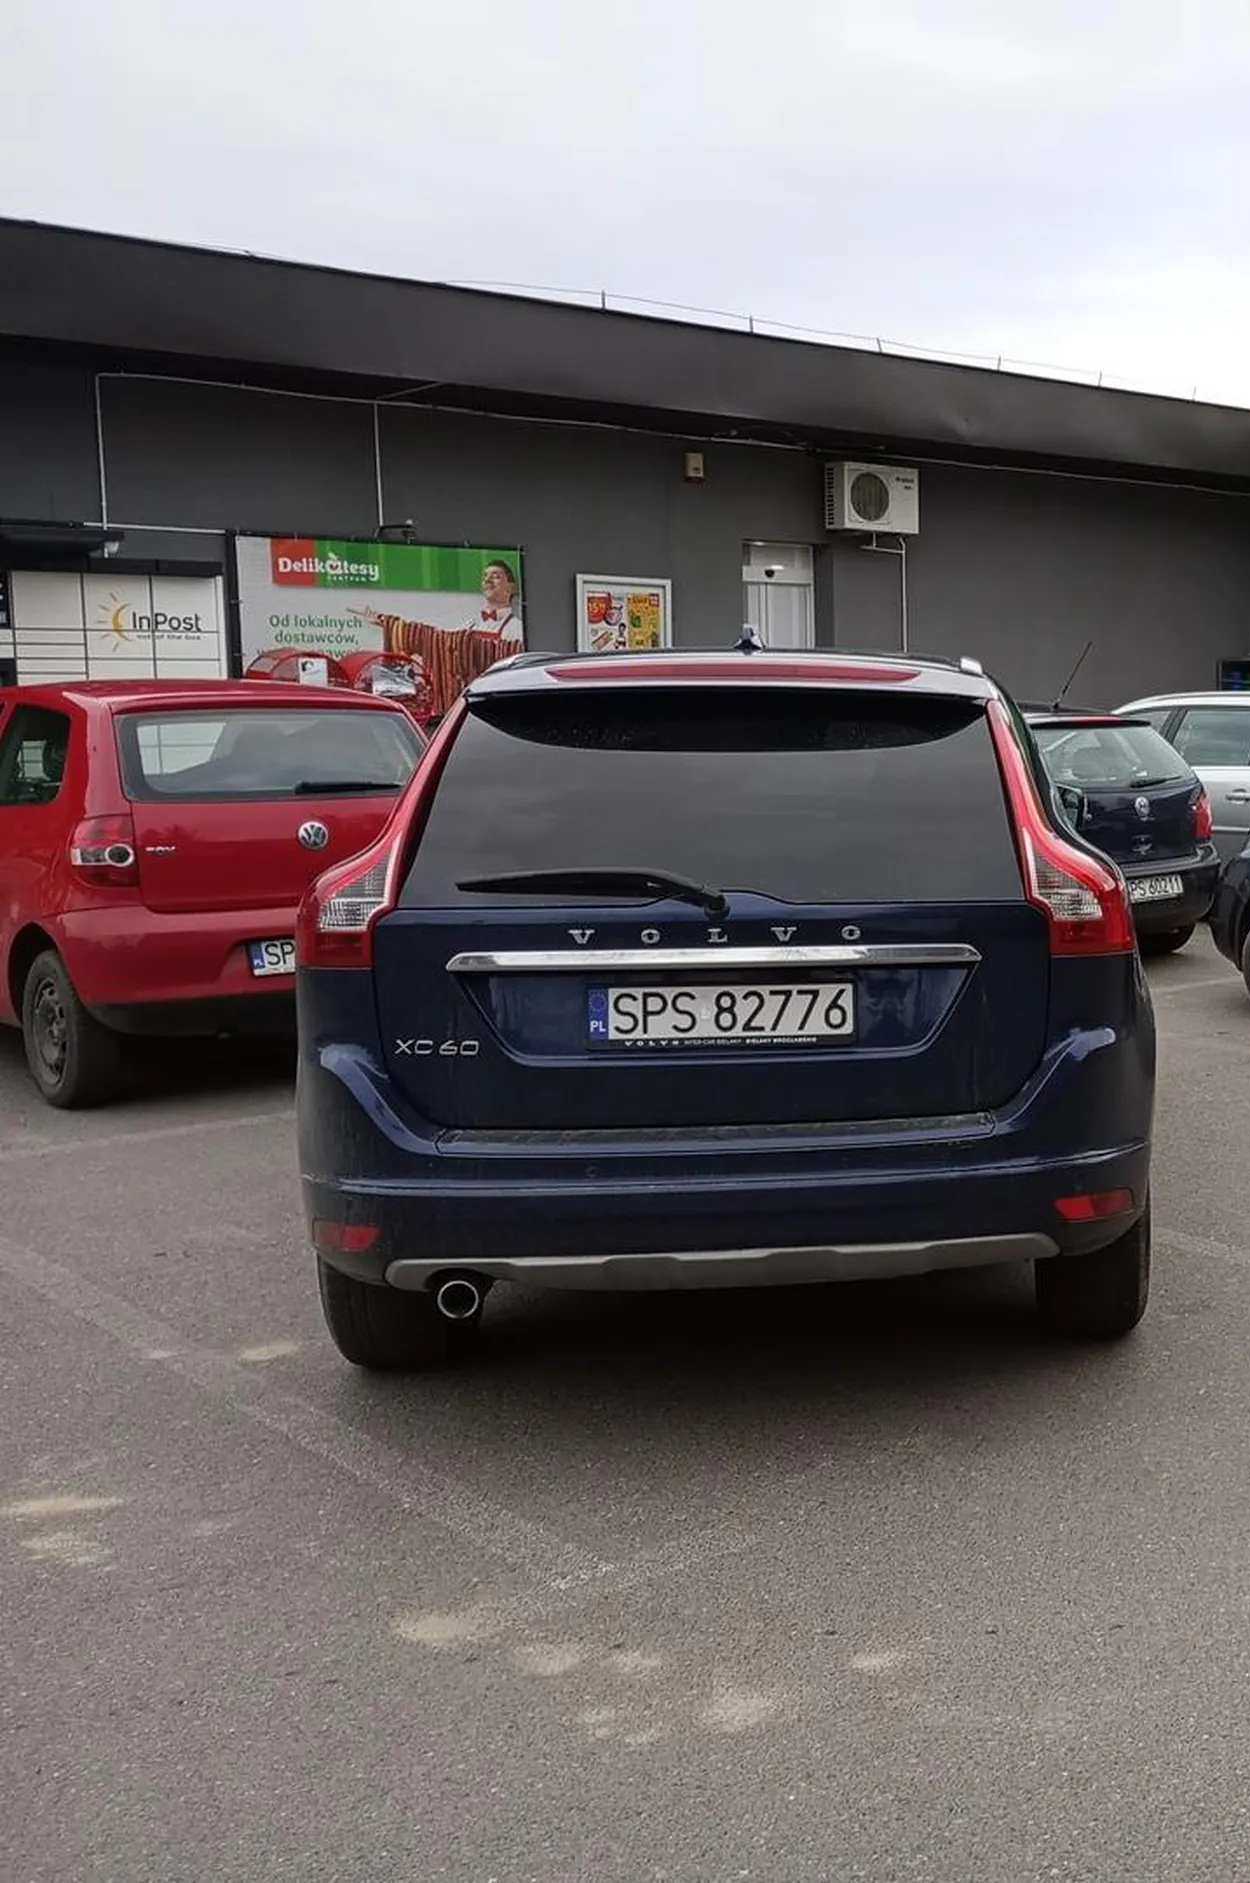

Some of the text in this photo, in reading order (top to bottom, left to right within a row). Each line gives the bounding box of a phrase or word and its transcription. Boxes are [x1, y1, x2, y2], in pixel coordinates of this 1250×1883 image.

[277, 554, 380, 581] Delikatesy
[132, 611, 203, 633] InPost
[269, 614, 363, 634] Od lokalnych
[568, 925, 861, 944] VOLVO
[613, 988, 847, 1035] SPS 82776
[589, 1021, 606, 1032] PL
